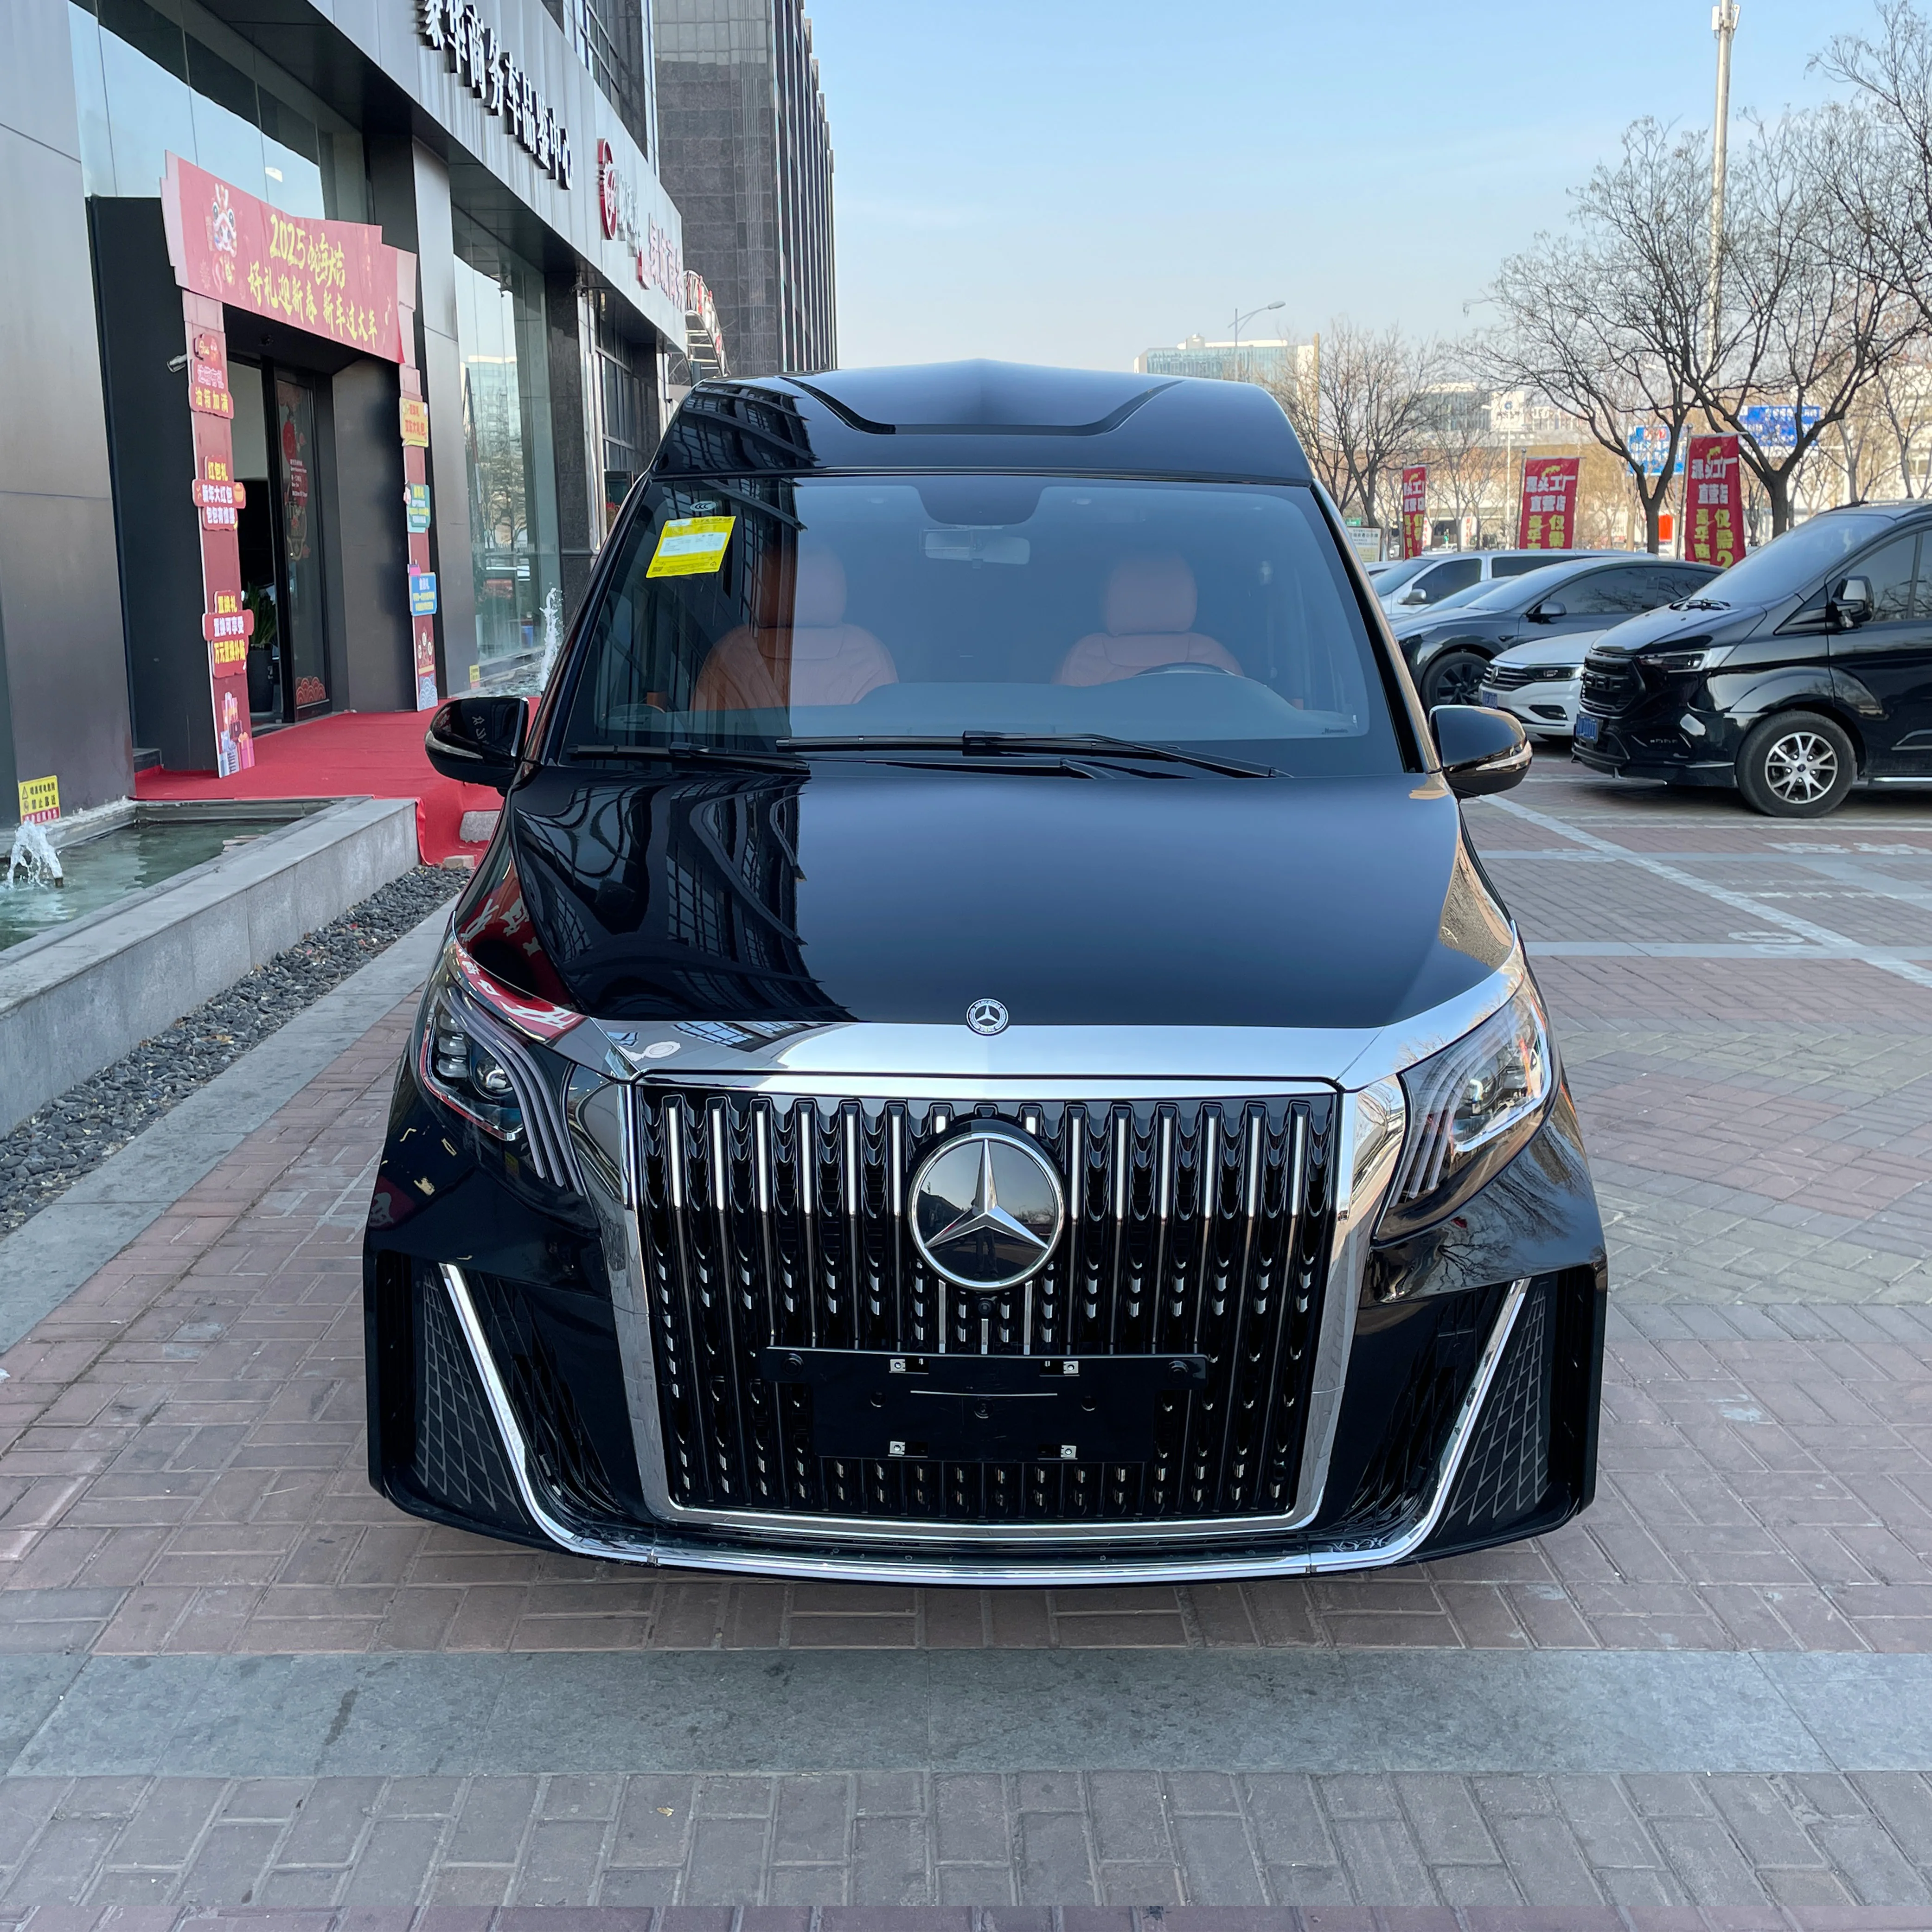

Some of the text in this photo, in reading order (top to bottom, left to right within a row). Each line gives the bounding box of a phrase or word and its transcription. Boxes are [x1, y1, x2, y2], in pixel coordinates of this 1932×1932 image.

[208, 461, 228, 481] 红包礼
[1526, 475, 1576, 493] 源头工厂
[1530, 495, 1566, 512] 直营店
